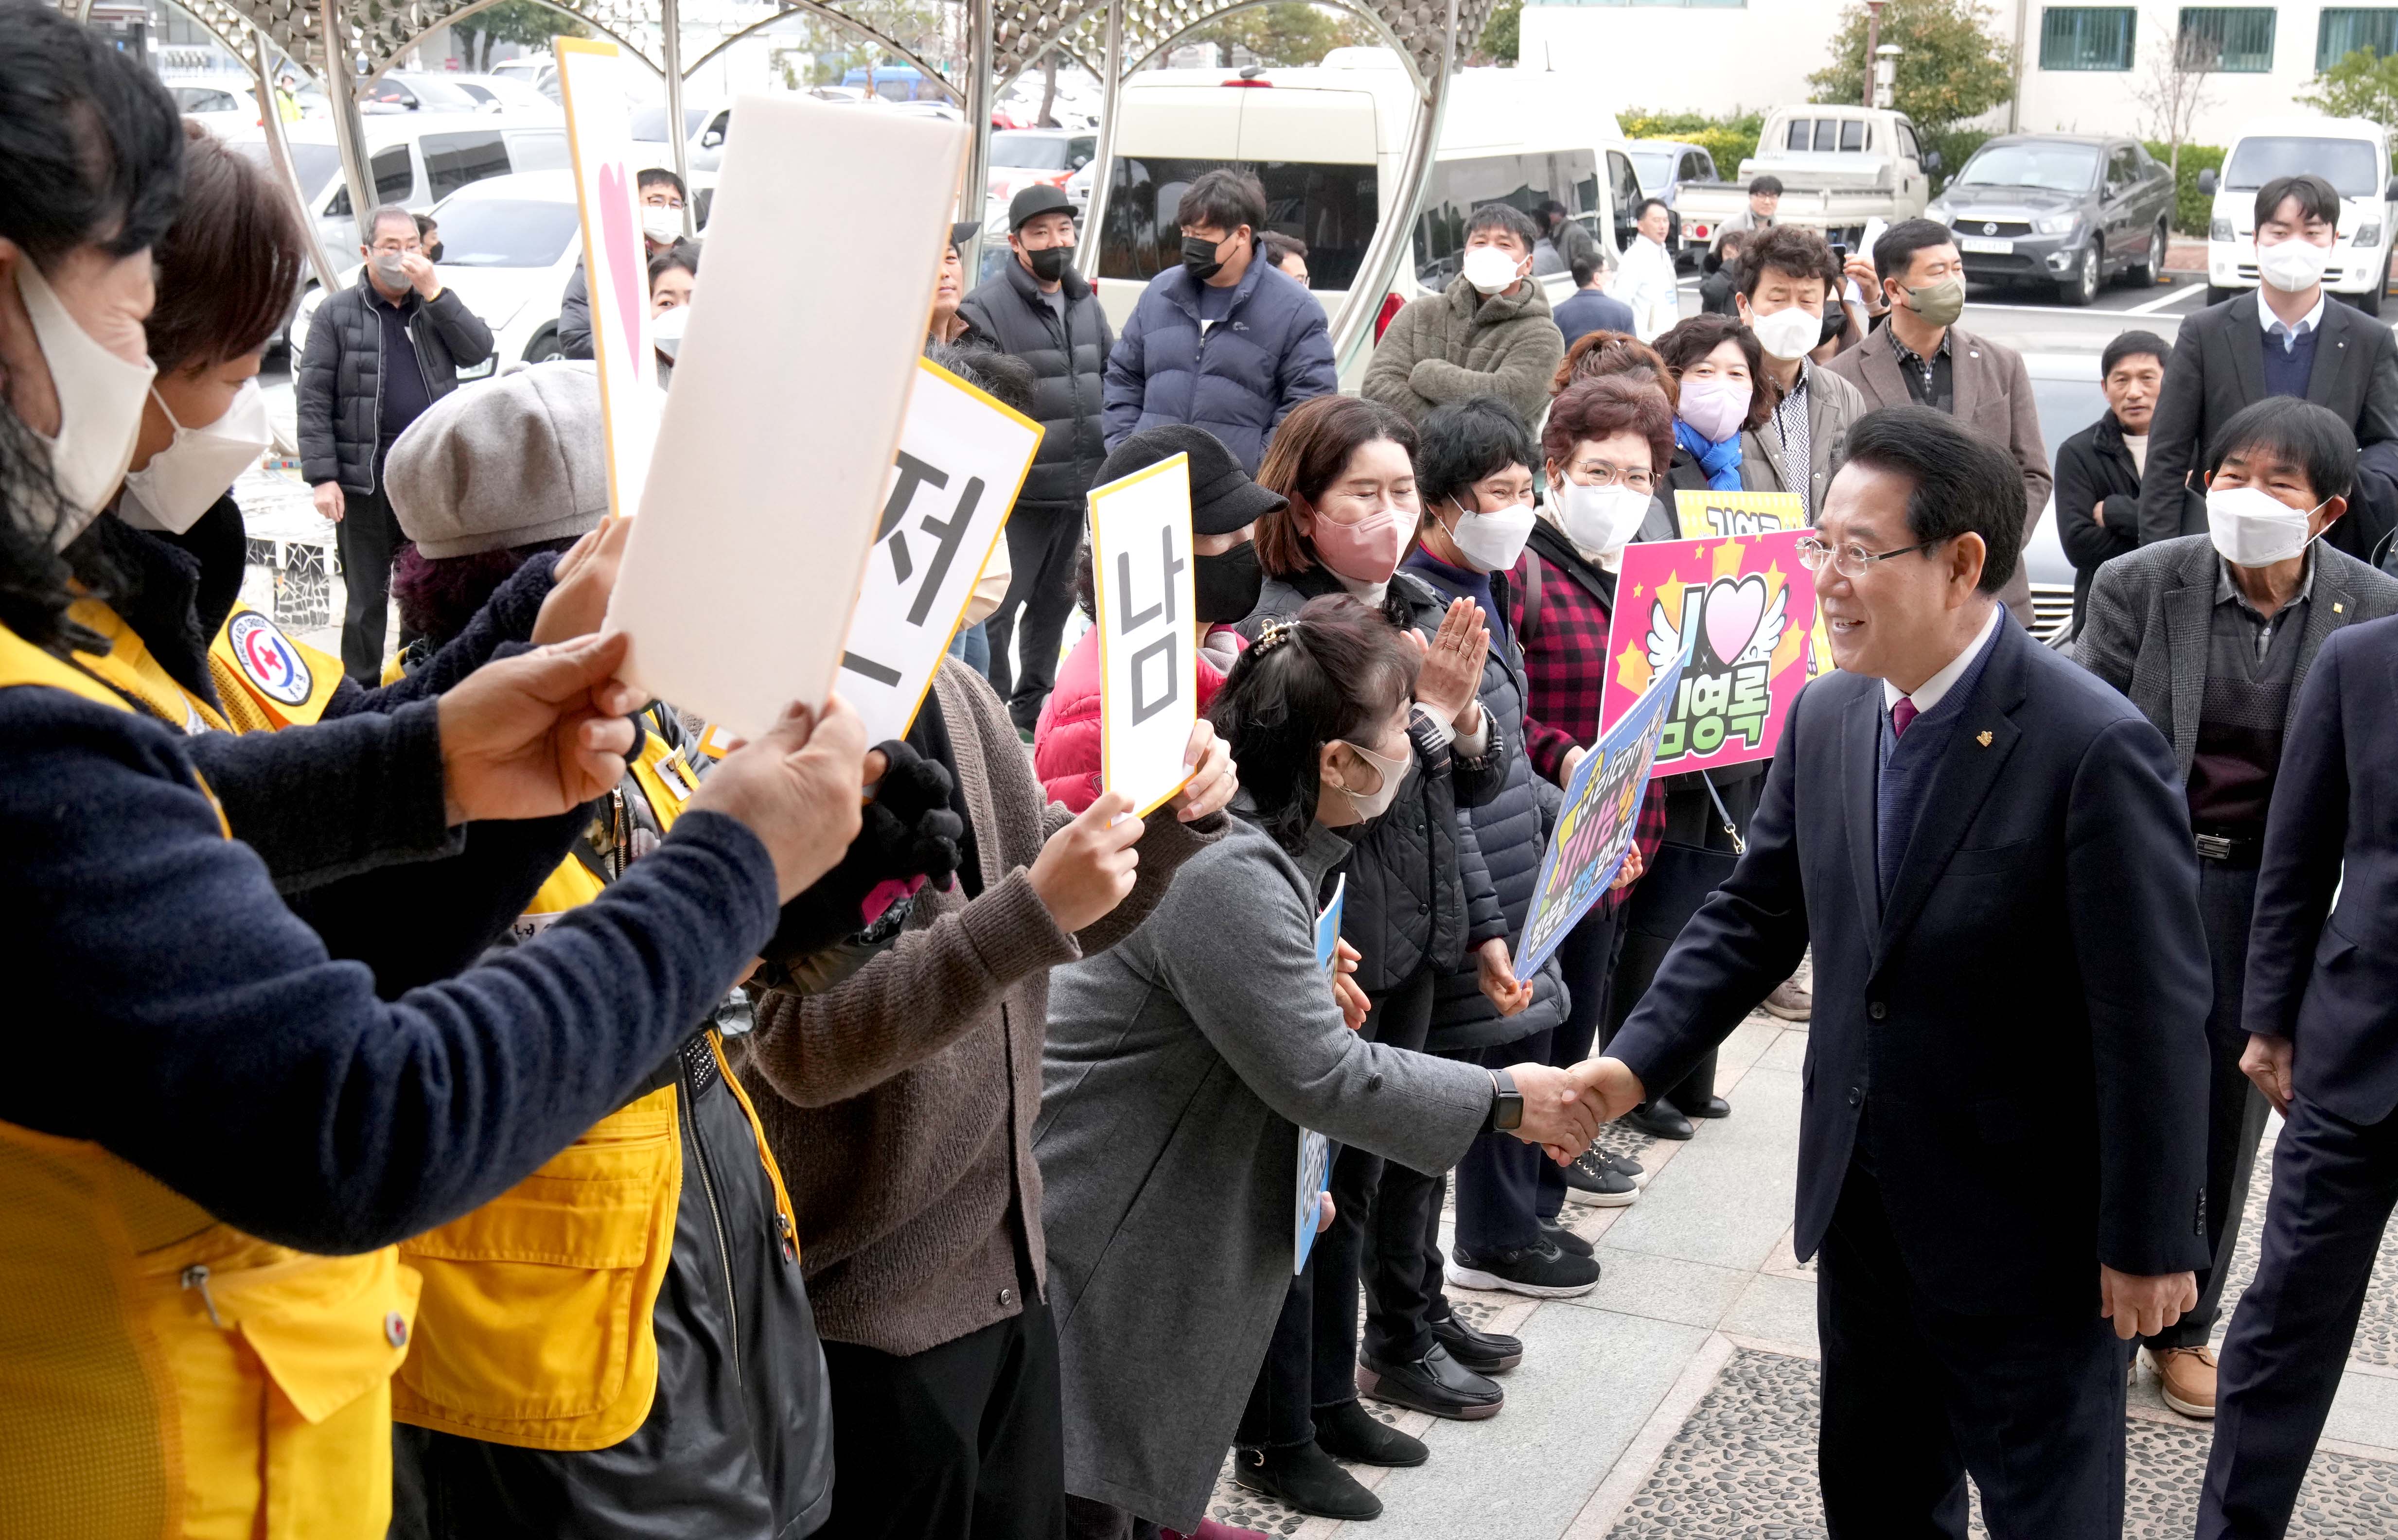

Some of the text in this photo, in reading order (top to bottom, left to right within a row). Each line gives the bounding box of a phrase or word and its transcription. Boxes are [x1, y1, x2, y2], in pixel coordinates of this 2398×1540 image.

[1118, 525, 1184, 727] 남
[1552, 775, 1629, 892] 지사님
[1531, 885, 1572, 954] 방문을
